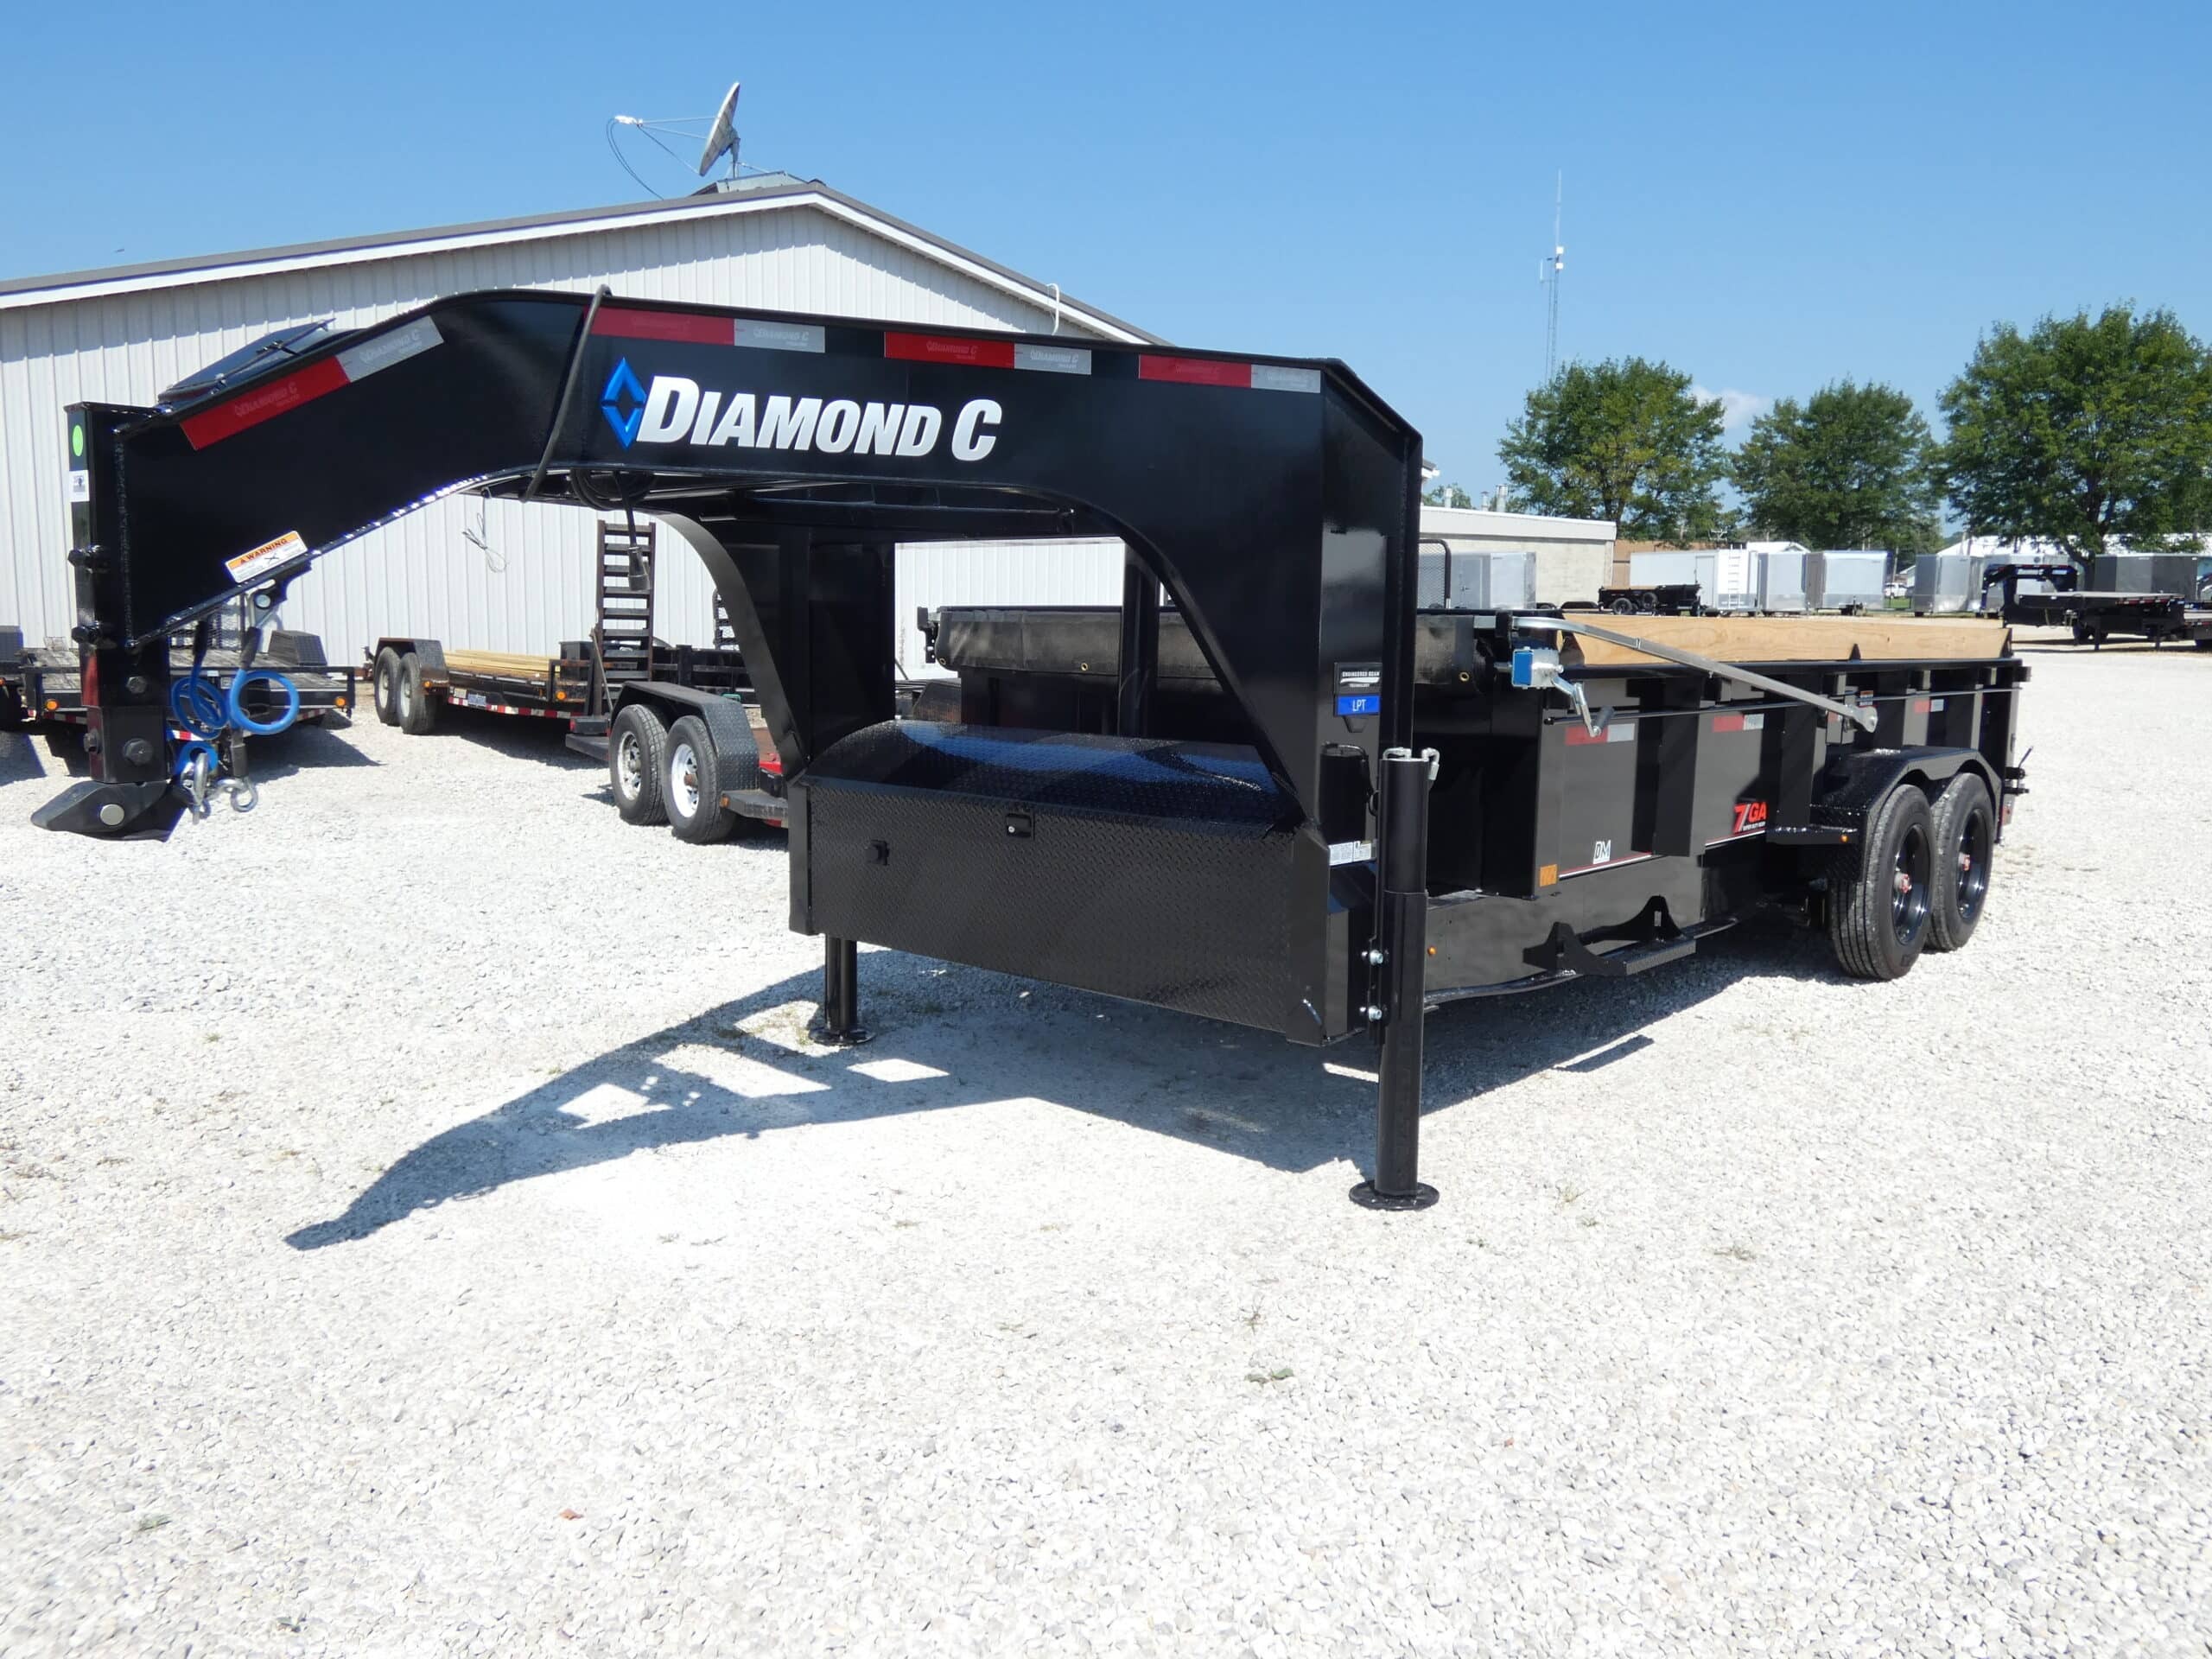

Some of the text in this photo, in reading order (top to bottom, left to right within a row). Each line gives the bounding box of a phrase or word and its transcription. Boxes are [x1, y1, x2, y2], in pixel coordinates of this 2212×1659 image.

[636, 375, 1002, 461] DIAMOND C
[245, 537, 288, 560] WARNING
[1352, 698, 1367, 712] LPT
[1593, 839, 1611, 863] DM
